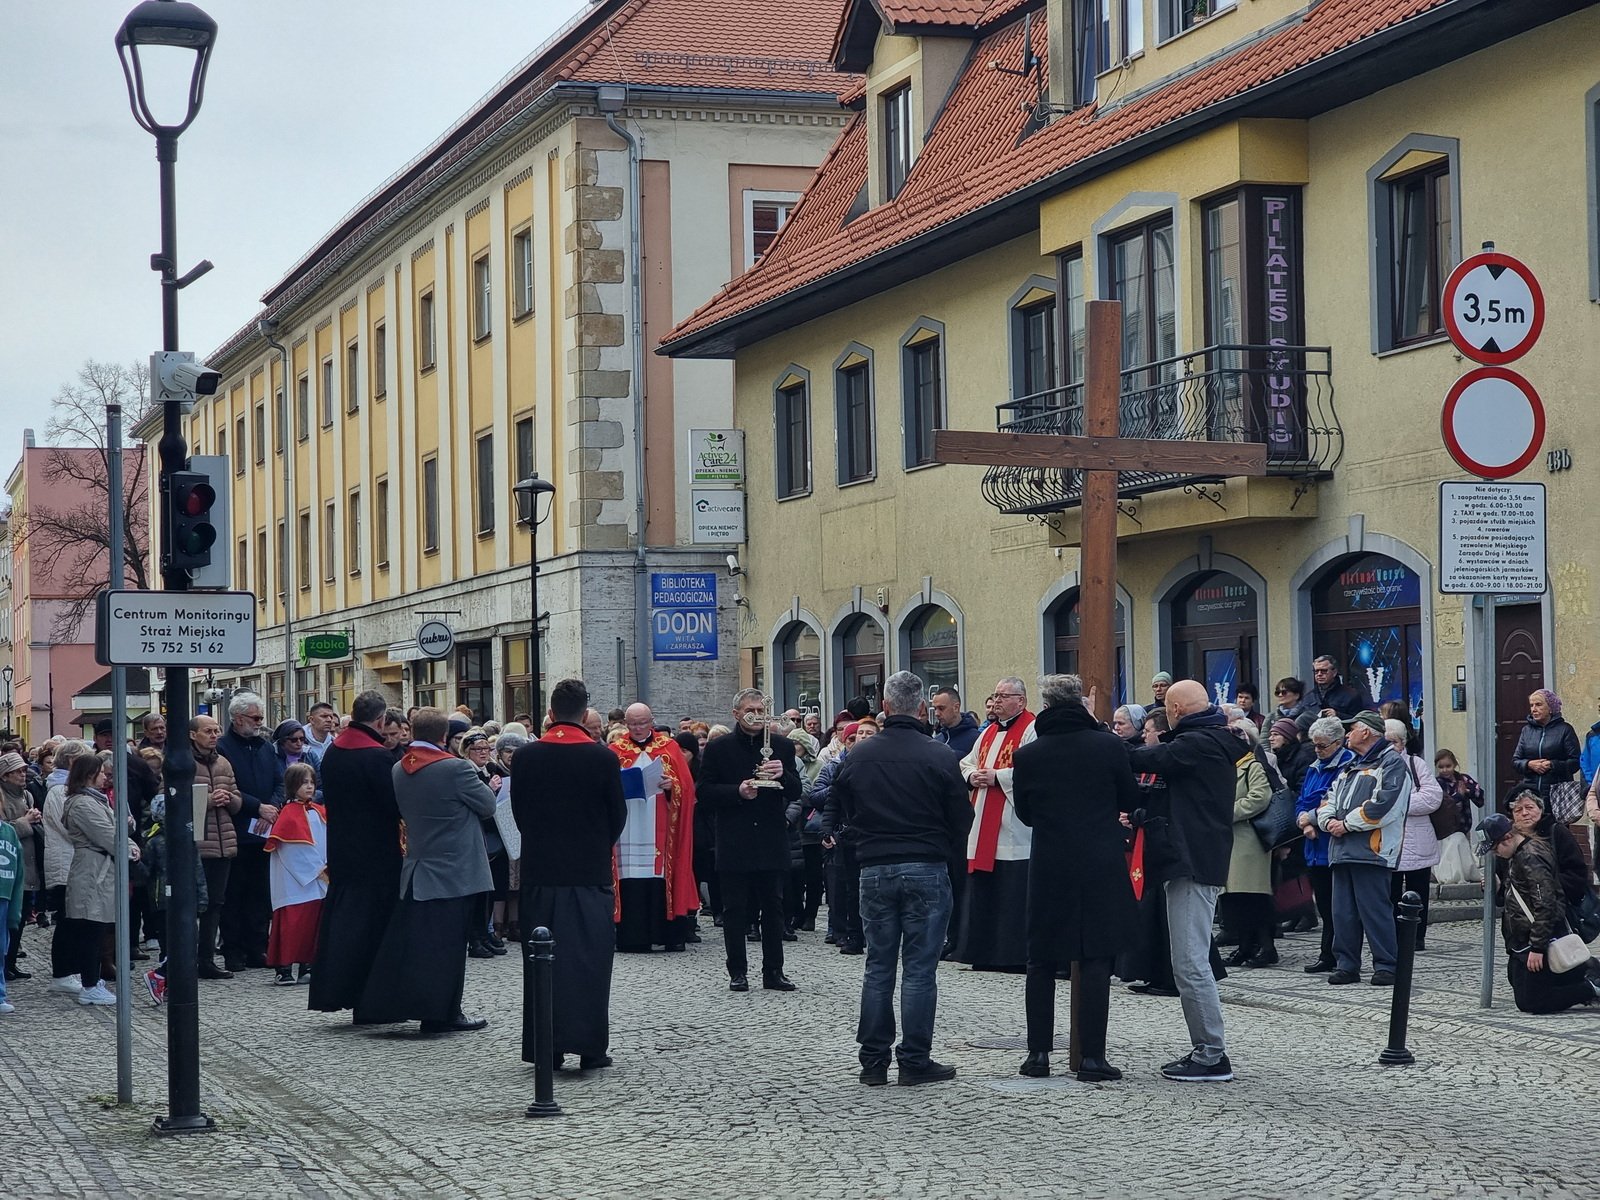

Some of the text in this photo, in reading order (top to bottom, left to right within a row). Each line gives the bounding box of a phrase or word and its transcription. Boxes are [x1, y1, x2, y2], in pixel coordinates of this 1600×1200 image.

[1266, 200, 1288, 322] PILATES
[697, 452, 724, 461] Active
[703, 452, 738, 468] Care 24
[662, 578, 706, 588] BIBLIOTEKA
[654, 592, 714, 603] PEDAGOGICZNA
[114, 608, 250, 623] Centrum Monitoringu
[657, 612, 712, 634] DODN
[140, 625, 226, 639] Straż Miejska
[422, 632, 449, 644] cukru
[142, 642, 224, 653] 75 752 51 62
[310, 639, 345, 649] żabka
